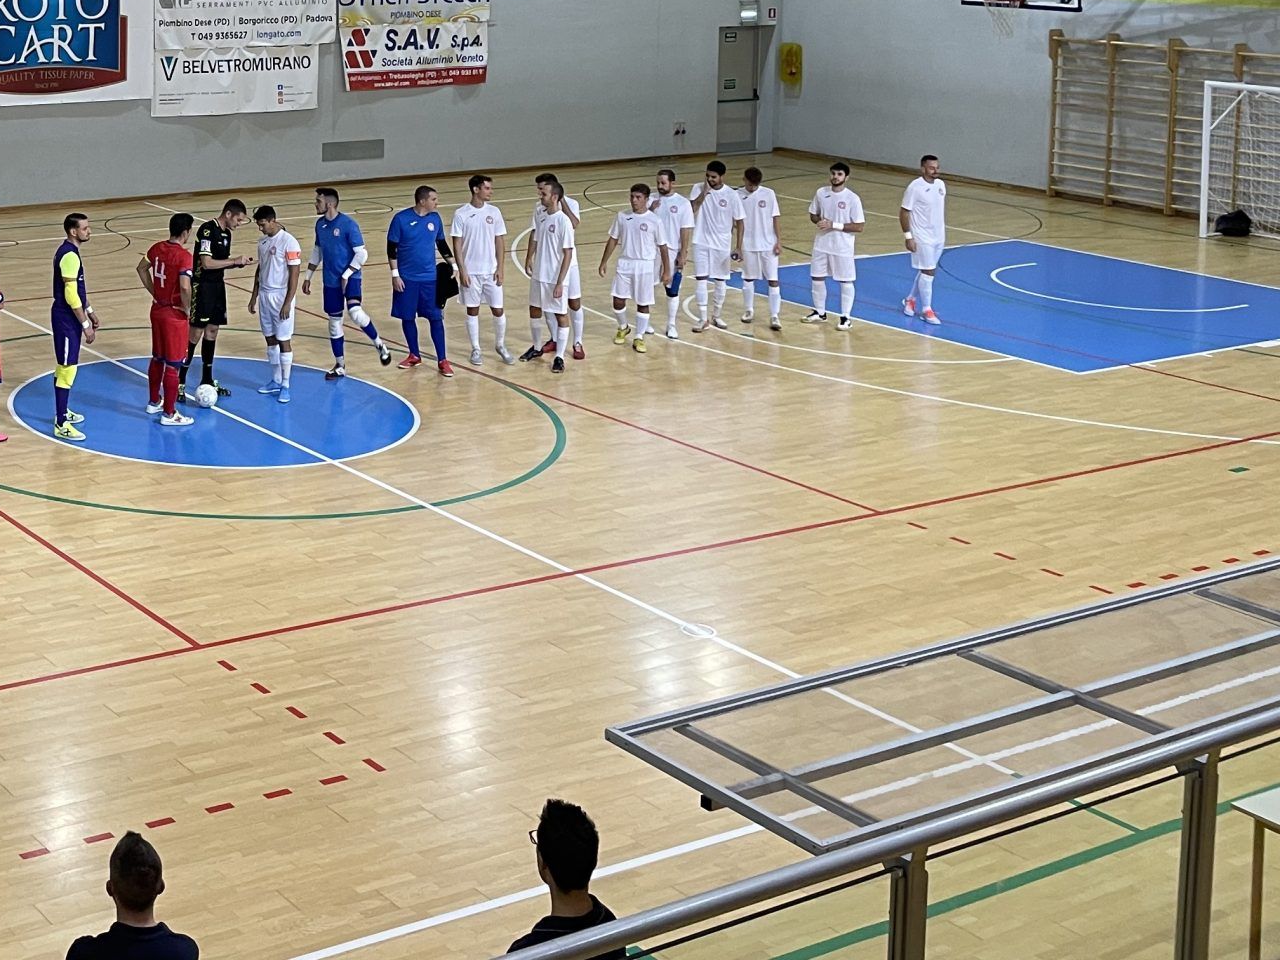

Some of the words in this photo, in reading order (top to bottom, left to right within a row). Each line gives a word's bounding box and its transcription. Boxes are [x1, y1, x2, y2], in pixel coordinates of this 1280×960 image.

[196, 1, 253, 9] SERRAMENTI
[158, 19, 192, 27] Piombino
[195, 18, 212, 26] Dese
[213, 17, 230, 27] (PD)
[238, 16, 279, 27] Borgoricco
[281, 15, 298, 25] (PD)
[305, 14, 333, 23] Padova
[390, 10, 424, 19] PIOMBINO
[198, 32, 213, 40] 049
[256, 30, 302, 40] longato.com
[385, 28, 440, 51] S.A.V.
[182, 55, 311, 75] BELVETROMURANO
[381, 55, 413, 67] Società
[415, 54, 453, 66] Alluminio
[456, 54, 484, 63] Veneto
[40, 70, 68, 80] TISSUE
[69, 70, 95, 80] PAPER
[154, 256, 166, 288] 4
